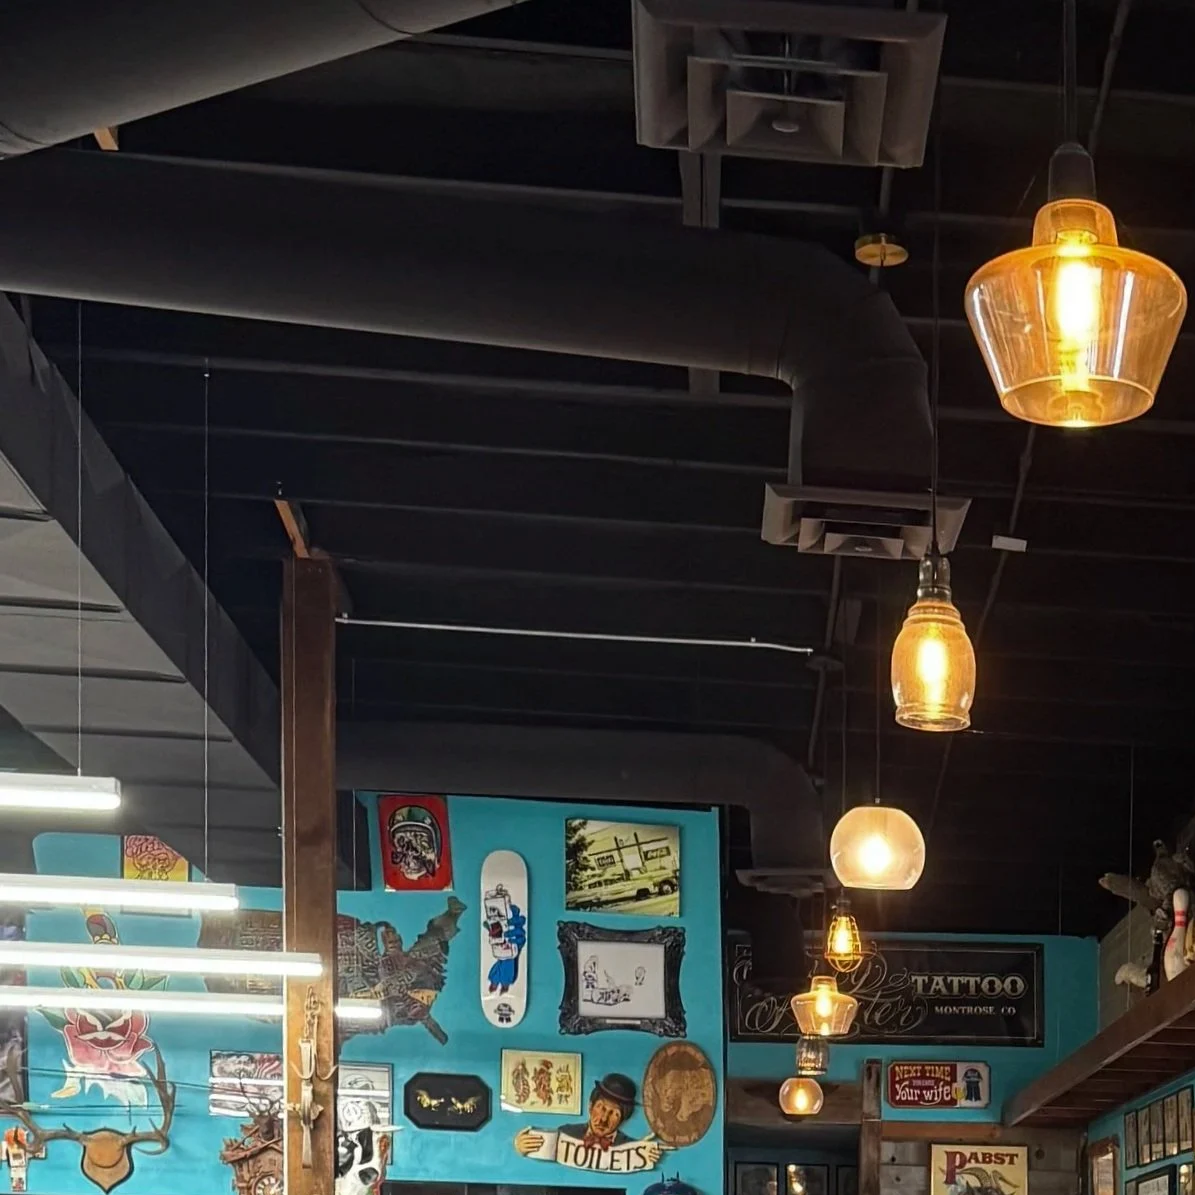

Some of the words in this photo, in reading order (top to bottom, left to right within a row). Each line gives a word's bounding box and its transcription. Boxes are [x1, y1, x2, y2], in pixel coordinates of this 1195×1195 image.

[911, 974, 1025, 997] TATTOO
[935, 1005, 995, 1015] MONTROSE
[1001, 1006, 1016, 1016] CO
[895, 1066, 922, 1081] NEXT
[925, 1066, 951, 1081] TIME
[895, 1081, 920, 1101] Your
[920, 1081, 951, 1105] wife
[561, 1140, 647, 1172] TOILETS
[944, 1151, 1018, 1185] PABST
